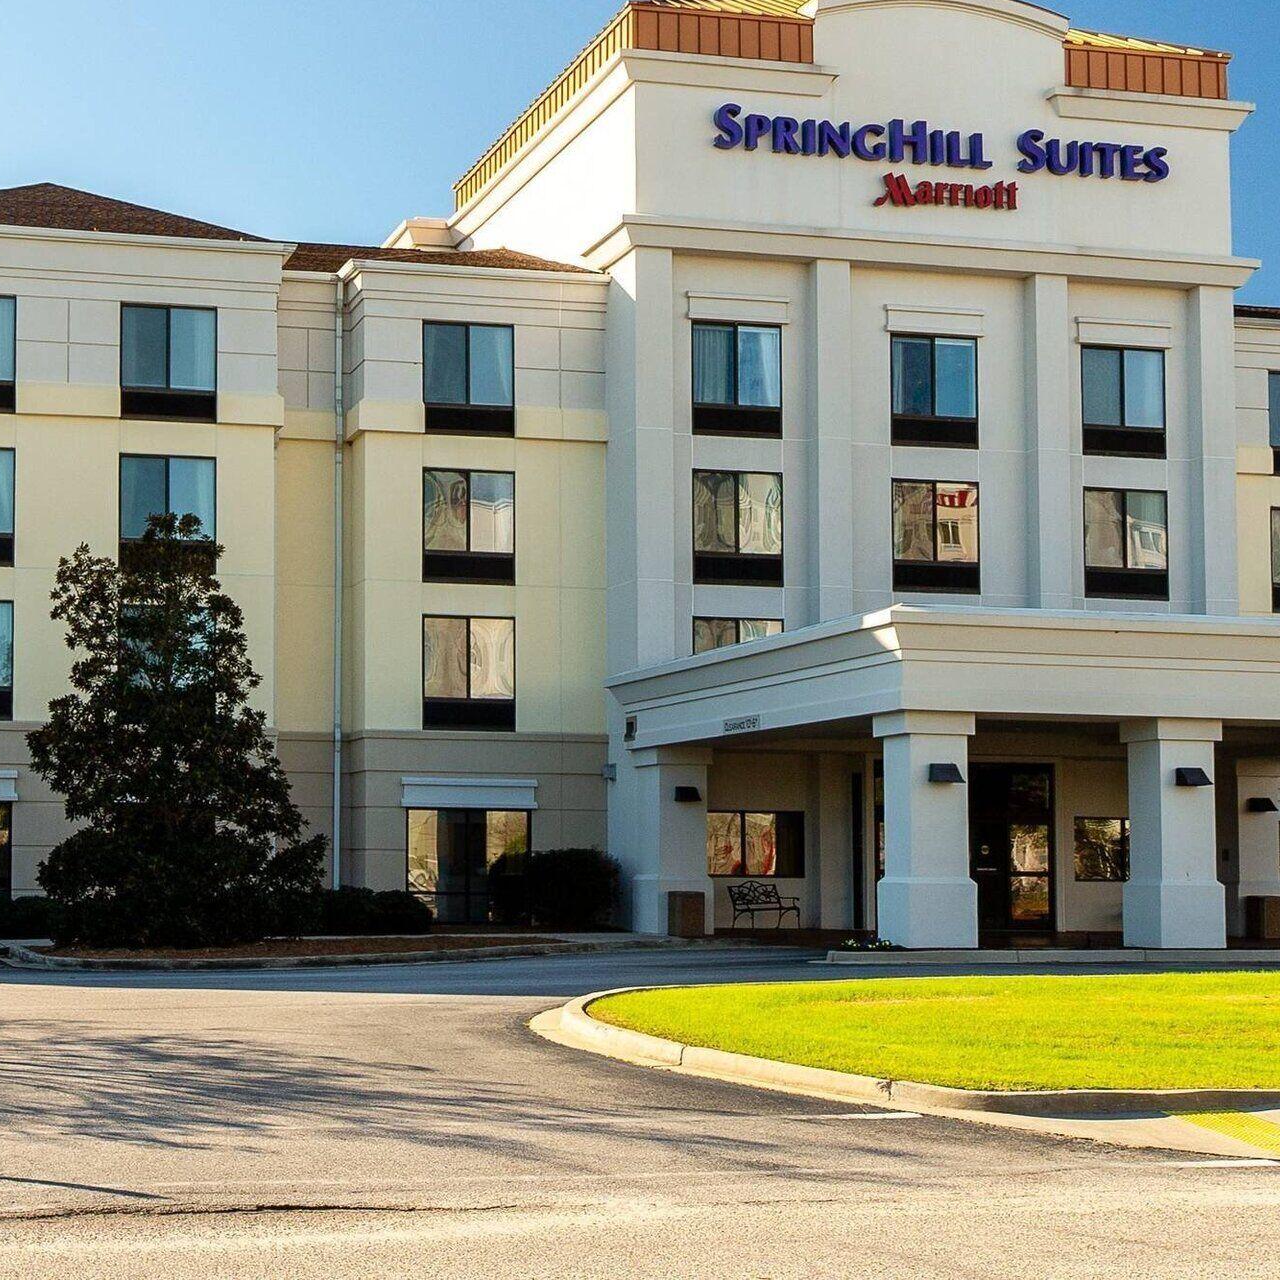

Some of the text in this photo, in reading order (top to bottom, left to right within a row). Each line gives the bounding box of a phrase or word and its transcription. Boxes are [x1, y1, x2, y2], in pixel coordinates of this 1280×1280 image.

[713, 103, 1170, 183] SPRINGHILL SUITES
[873, 172, 1018, 210] Marriott
